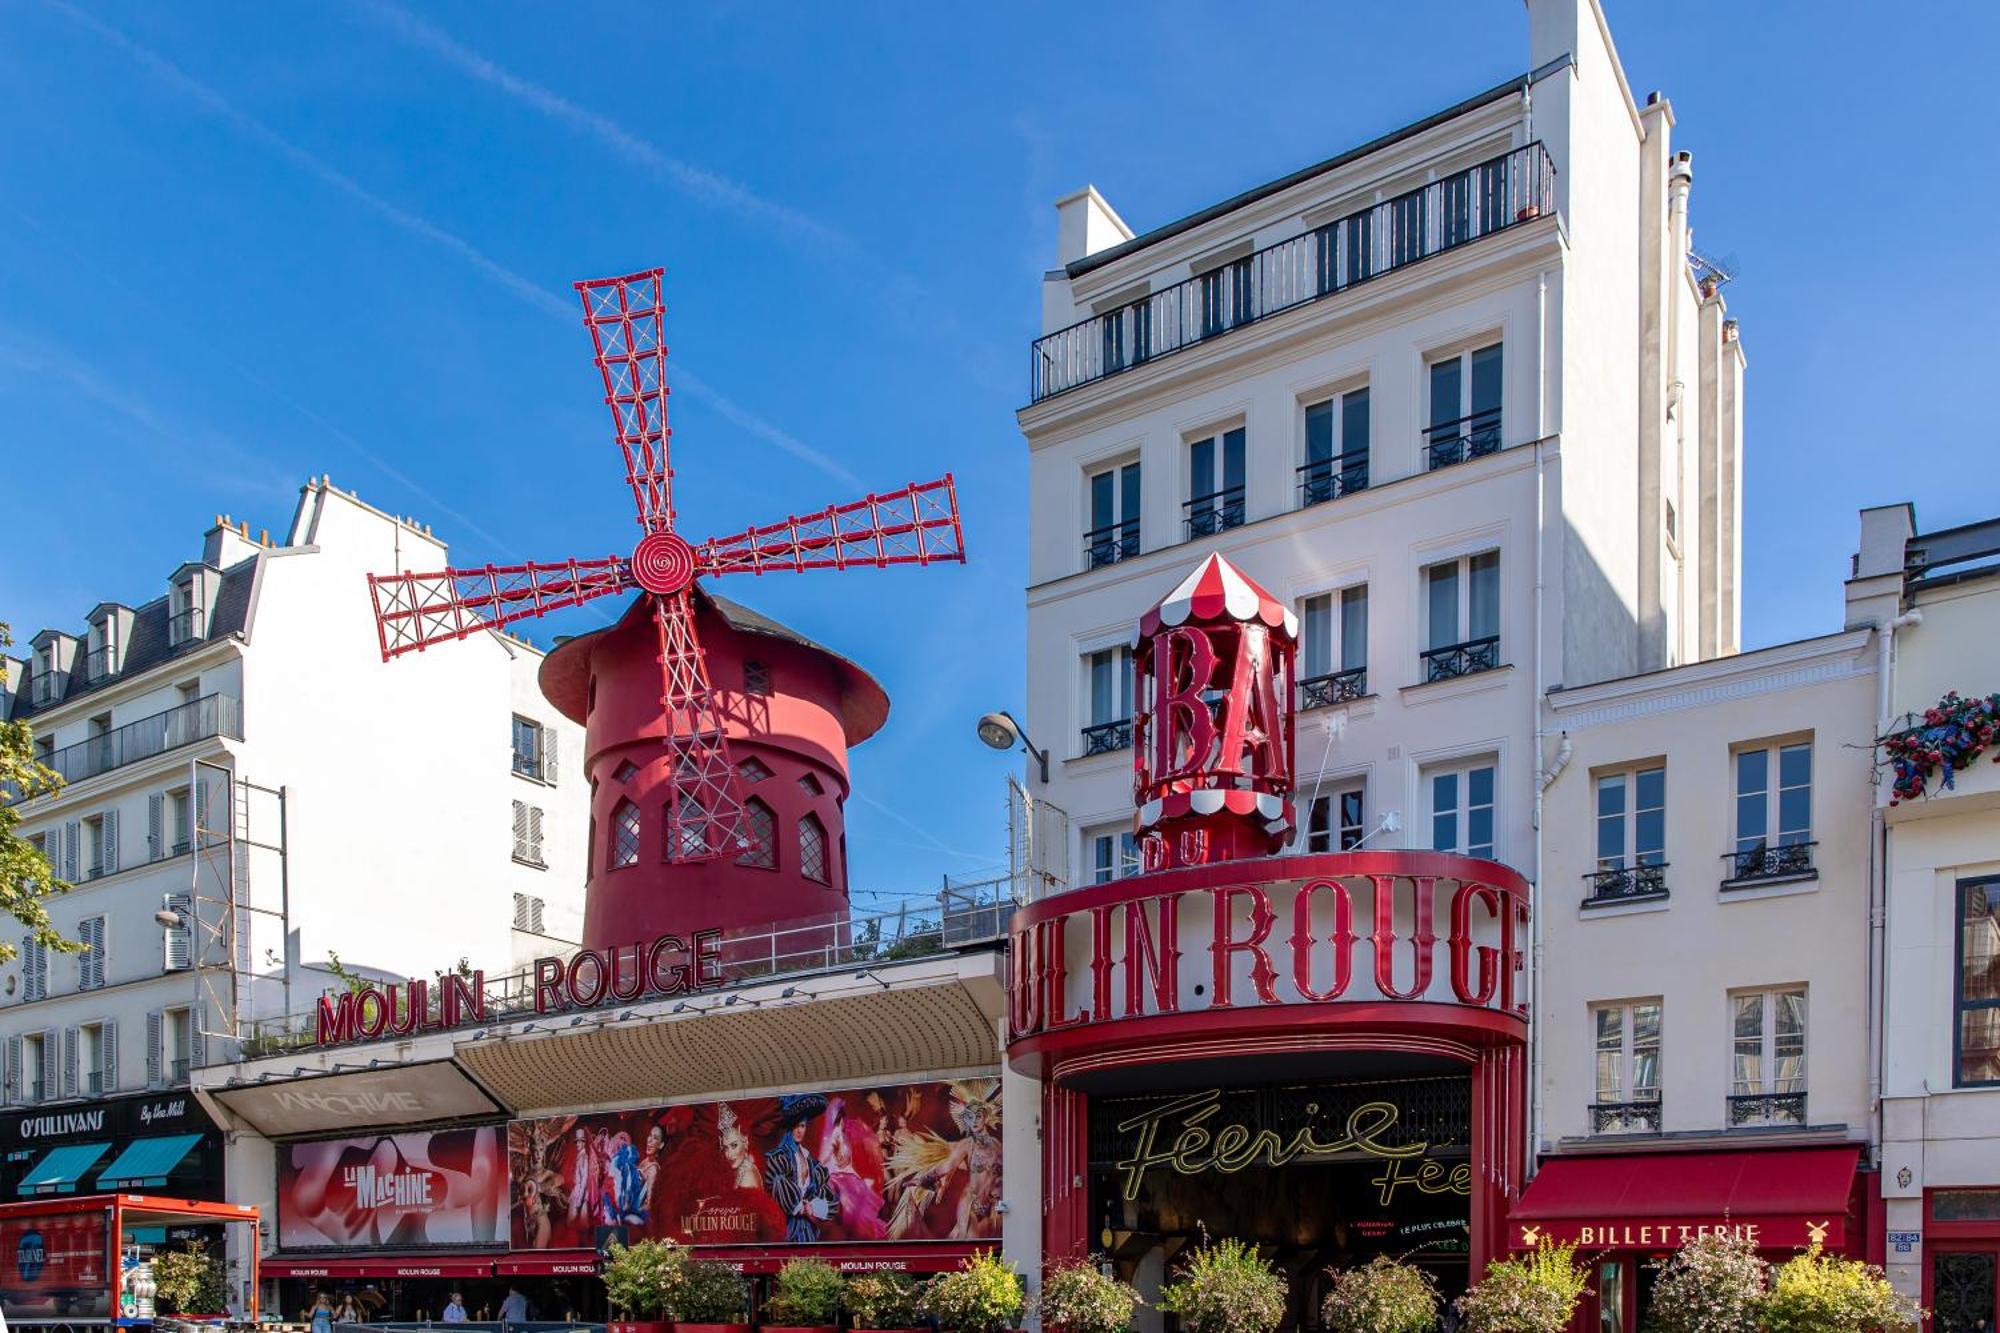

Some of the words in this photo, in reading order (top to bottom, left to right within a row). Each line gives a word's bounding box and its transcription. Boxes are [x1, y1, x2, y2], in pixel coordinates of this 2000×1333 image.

[316, 969, 485, 1045] MOULIN
[534, 929, 725, 1014] ROUGE
[20, 1110, 105, 1138] O'SULLIVANS
[1117, 1088, 1428, 1200] Féerie
[344, 1167, 356, 1182] LA
[681, 1213, 718, 1232] MOULIN
[720, 1213, 757, 1231] ROUGE
[1581, 1224, 1761, 1245] BILLETTERIE
[552, 1265, 578, 1273] MOULIN
[579, 1265, 595, 1273] ROU
[840, 1262, 874, 1270] MOULIN
[875, 1261, 907, 1269] ROUGE
